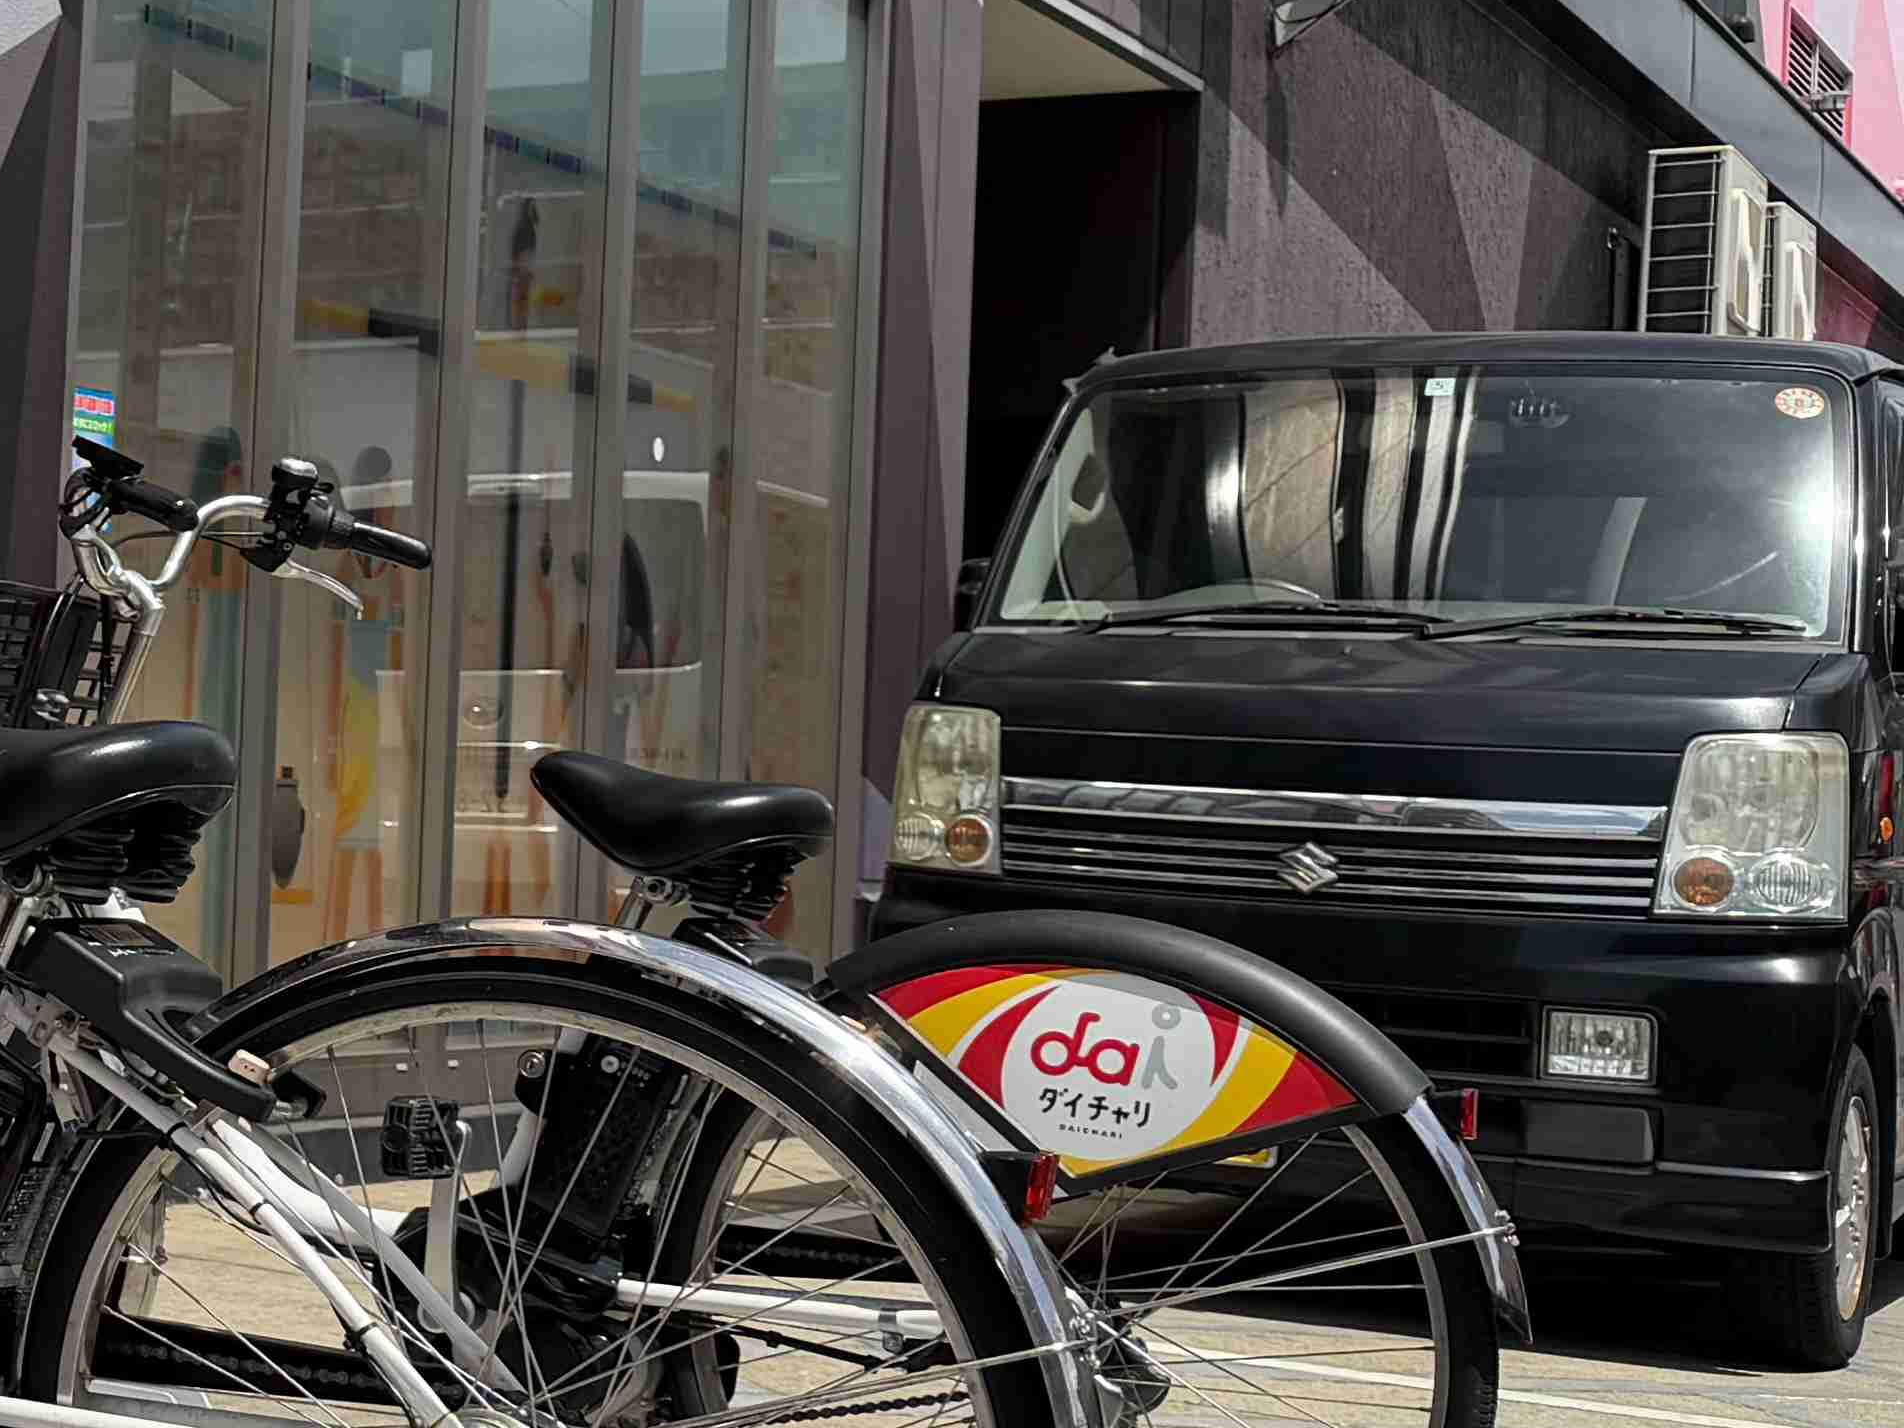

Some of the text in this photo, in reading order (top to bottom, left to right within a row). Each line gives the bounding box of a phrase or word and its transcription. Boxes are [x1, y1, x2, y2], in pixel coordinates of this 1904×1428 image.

[1030, 1003, 1182, 1090] dai
[1040, 1088, 1151, 1127] ダイチャリ
[1059, 1123, 1123, 1139] DAICHARI
